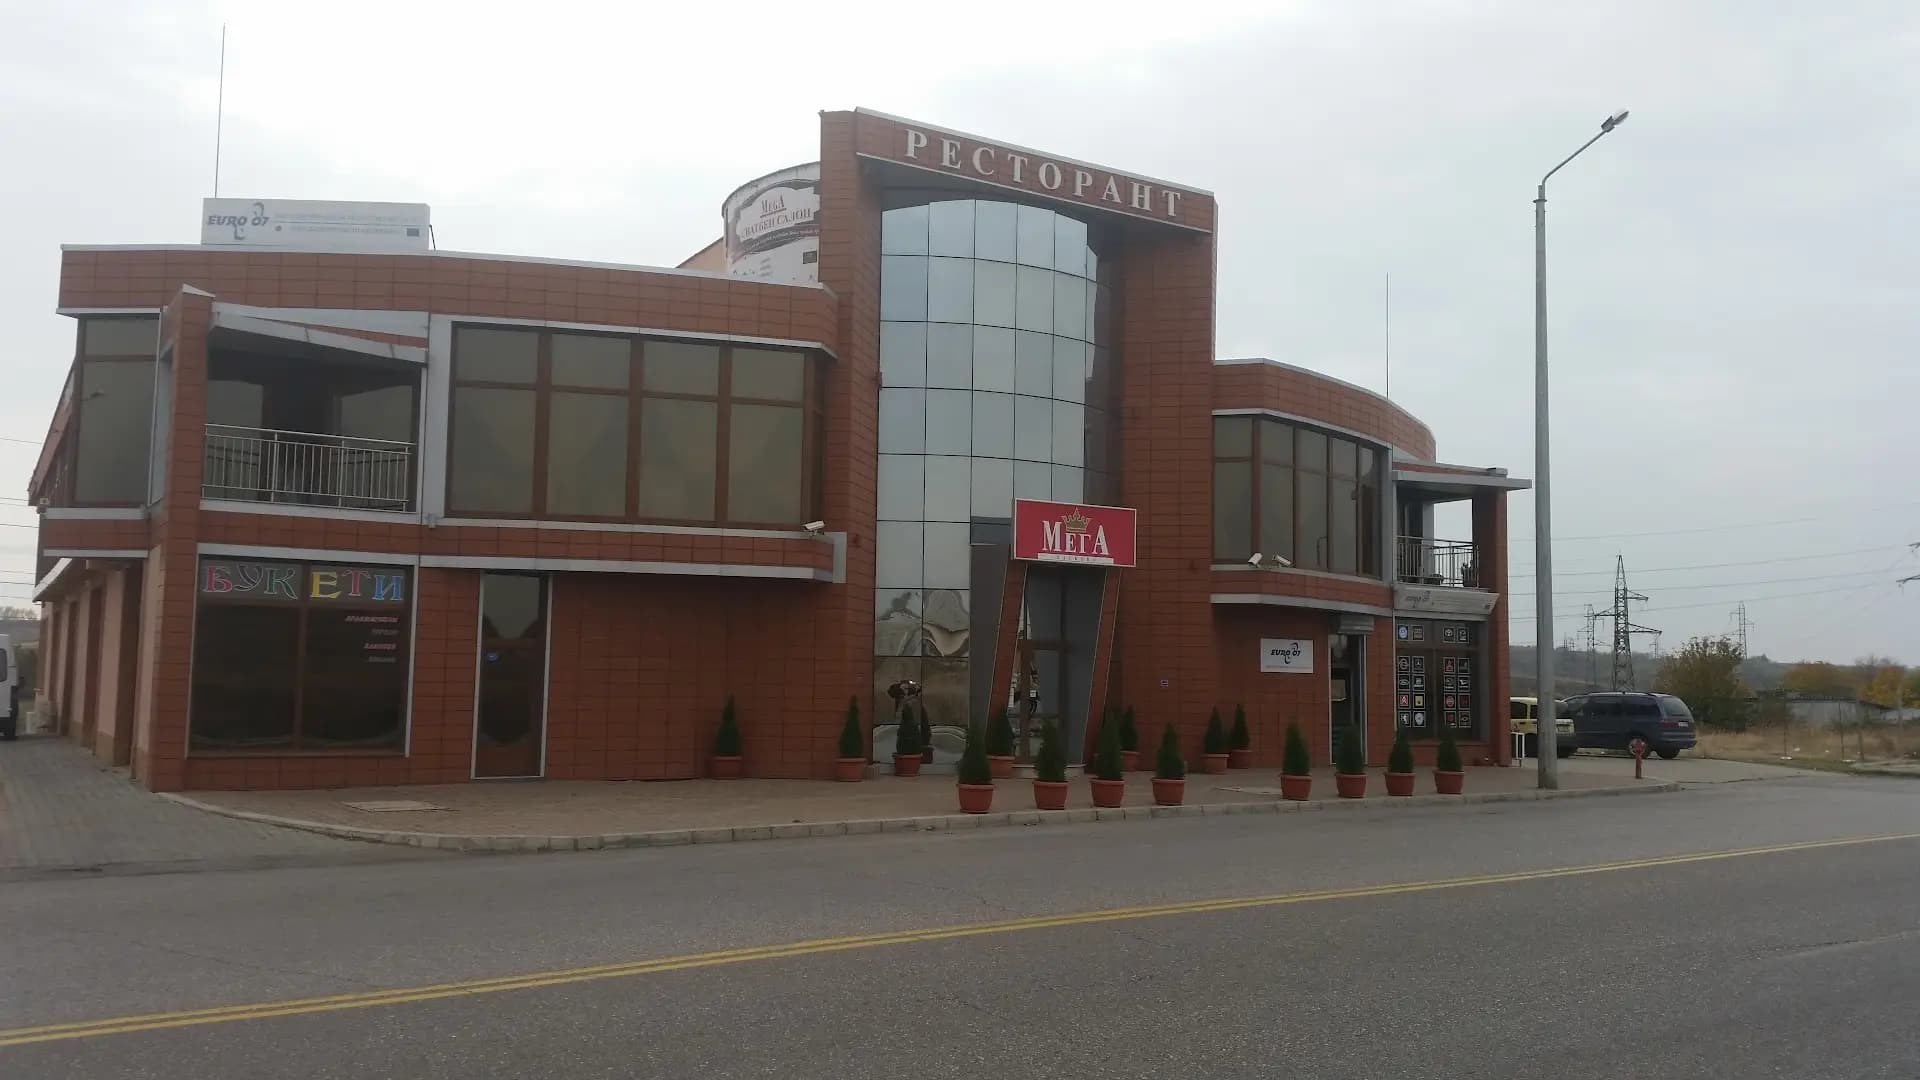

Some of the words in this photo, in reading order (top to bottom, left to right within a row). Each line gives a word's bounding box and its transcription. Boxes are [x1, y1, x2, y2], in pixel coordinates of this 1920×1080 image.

[904, 128, 1181, 217] РЕСТОРАНТ
[207, 214, 247, 227] EURO
[251, 216, 270, 227] 07
